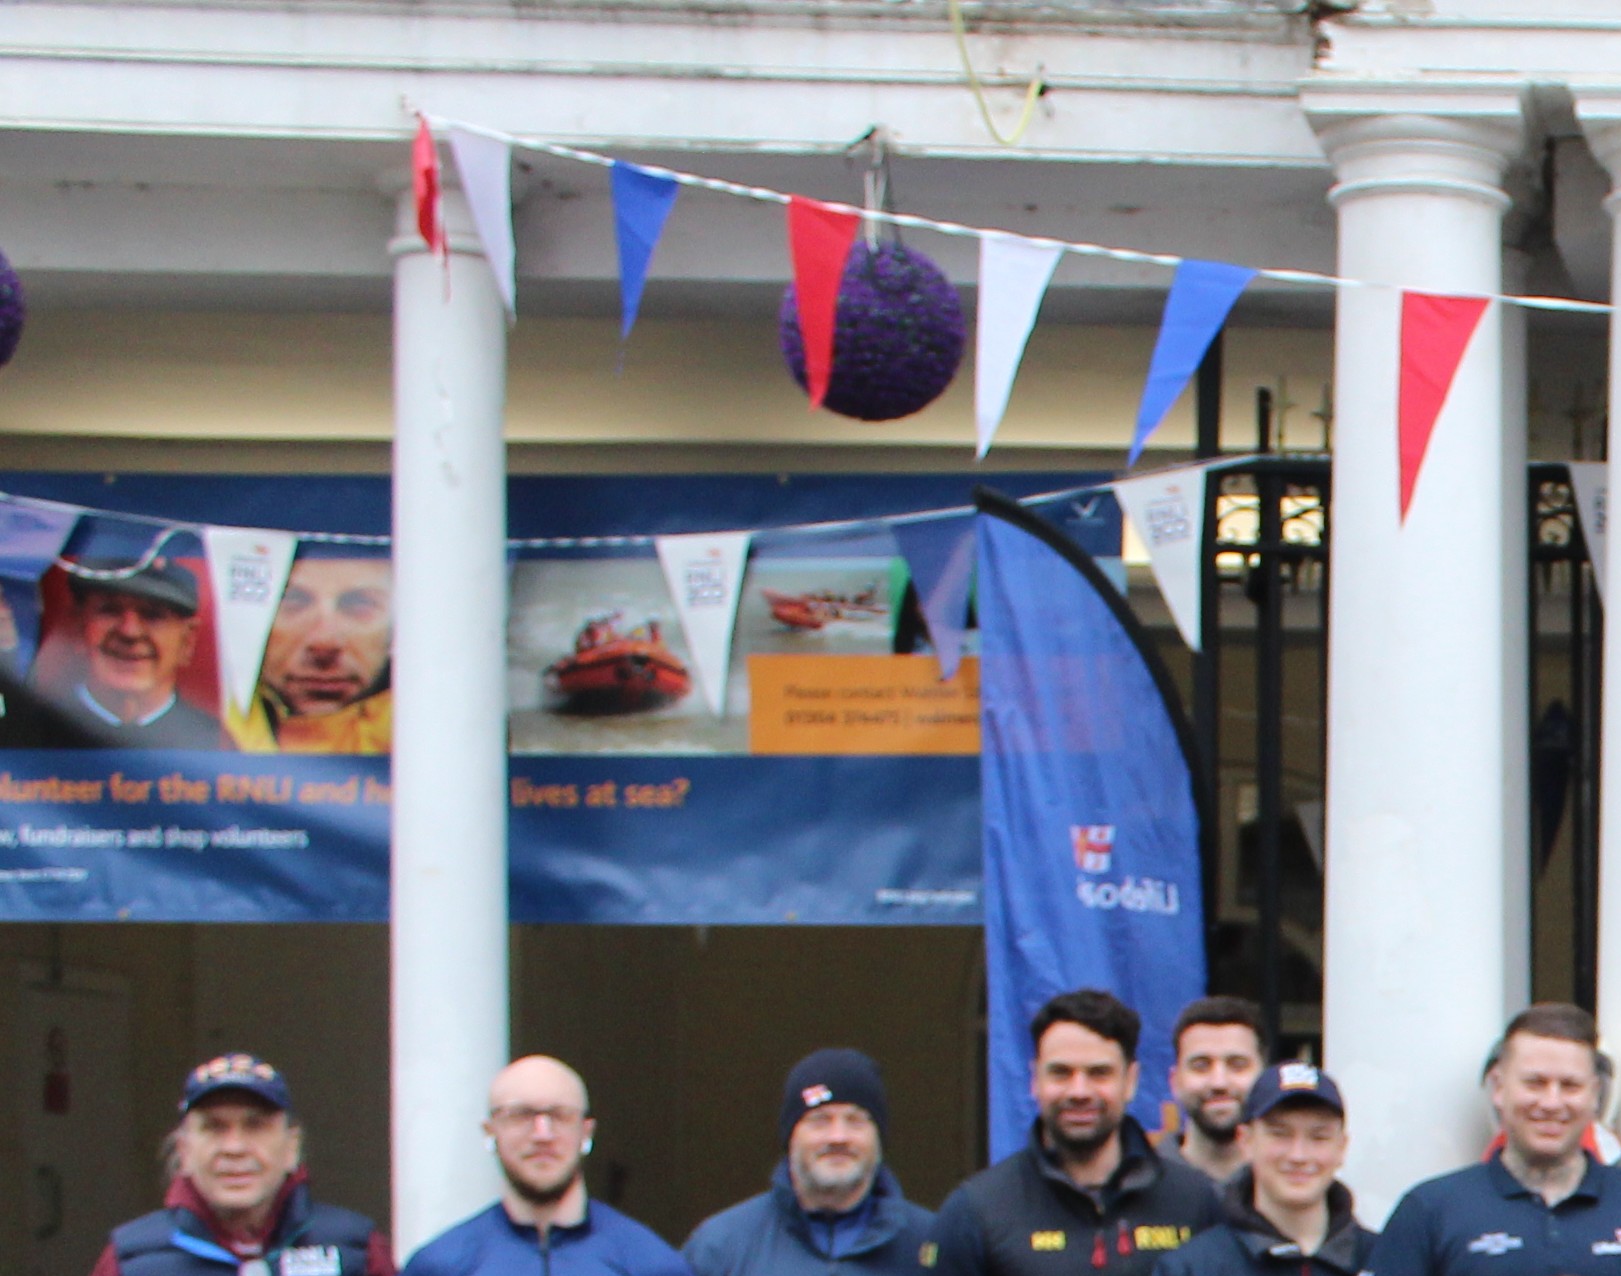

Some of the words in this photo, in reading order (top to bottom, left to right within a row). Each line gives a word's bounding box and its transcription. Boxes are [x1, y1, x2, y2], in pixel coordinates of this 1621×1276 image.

[0, 771, 103, 802] lunteer
[109, 772, 150, 802] for
[158, 771, 209, 803] the
[216, 774, 293, 802] RNLI
[297, 776, 359, 804] and
[510, 778, 577, 806] lives
[584, 780, 616, 807] at
[623, 777, 690, 807] sea?
[1132, 1225, 1190, 1250] RNLI
